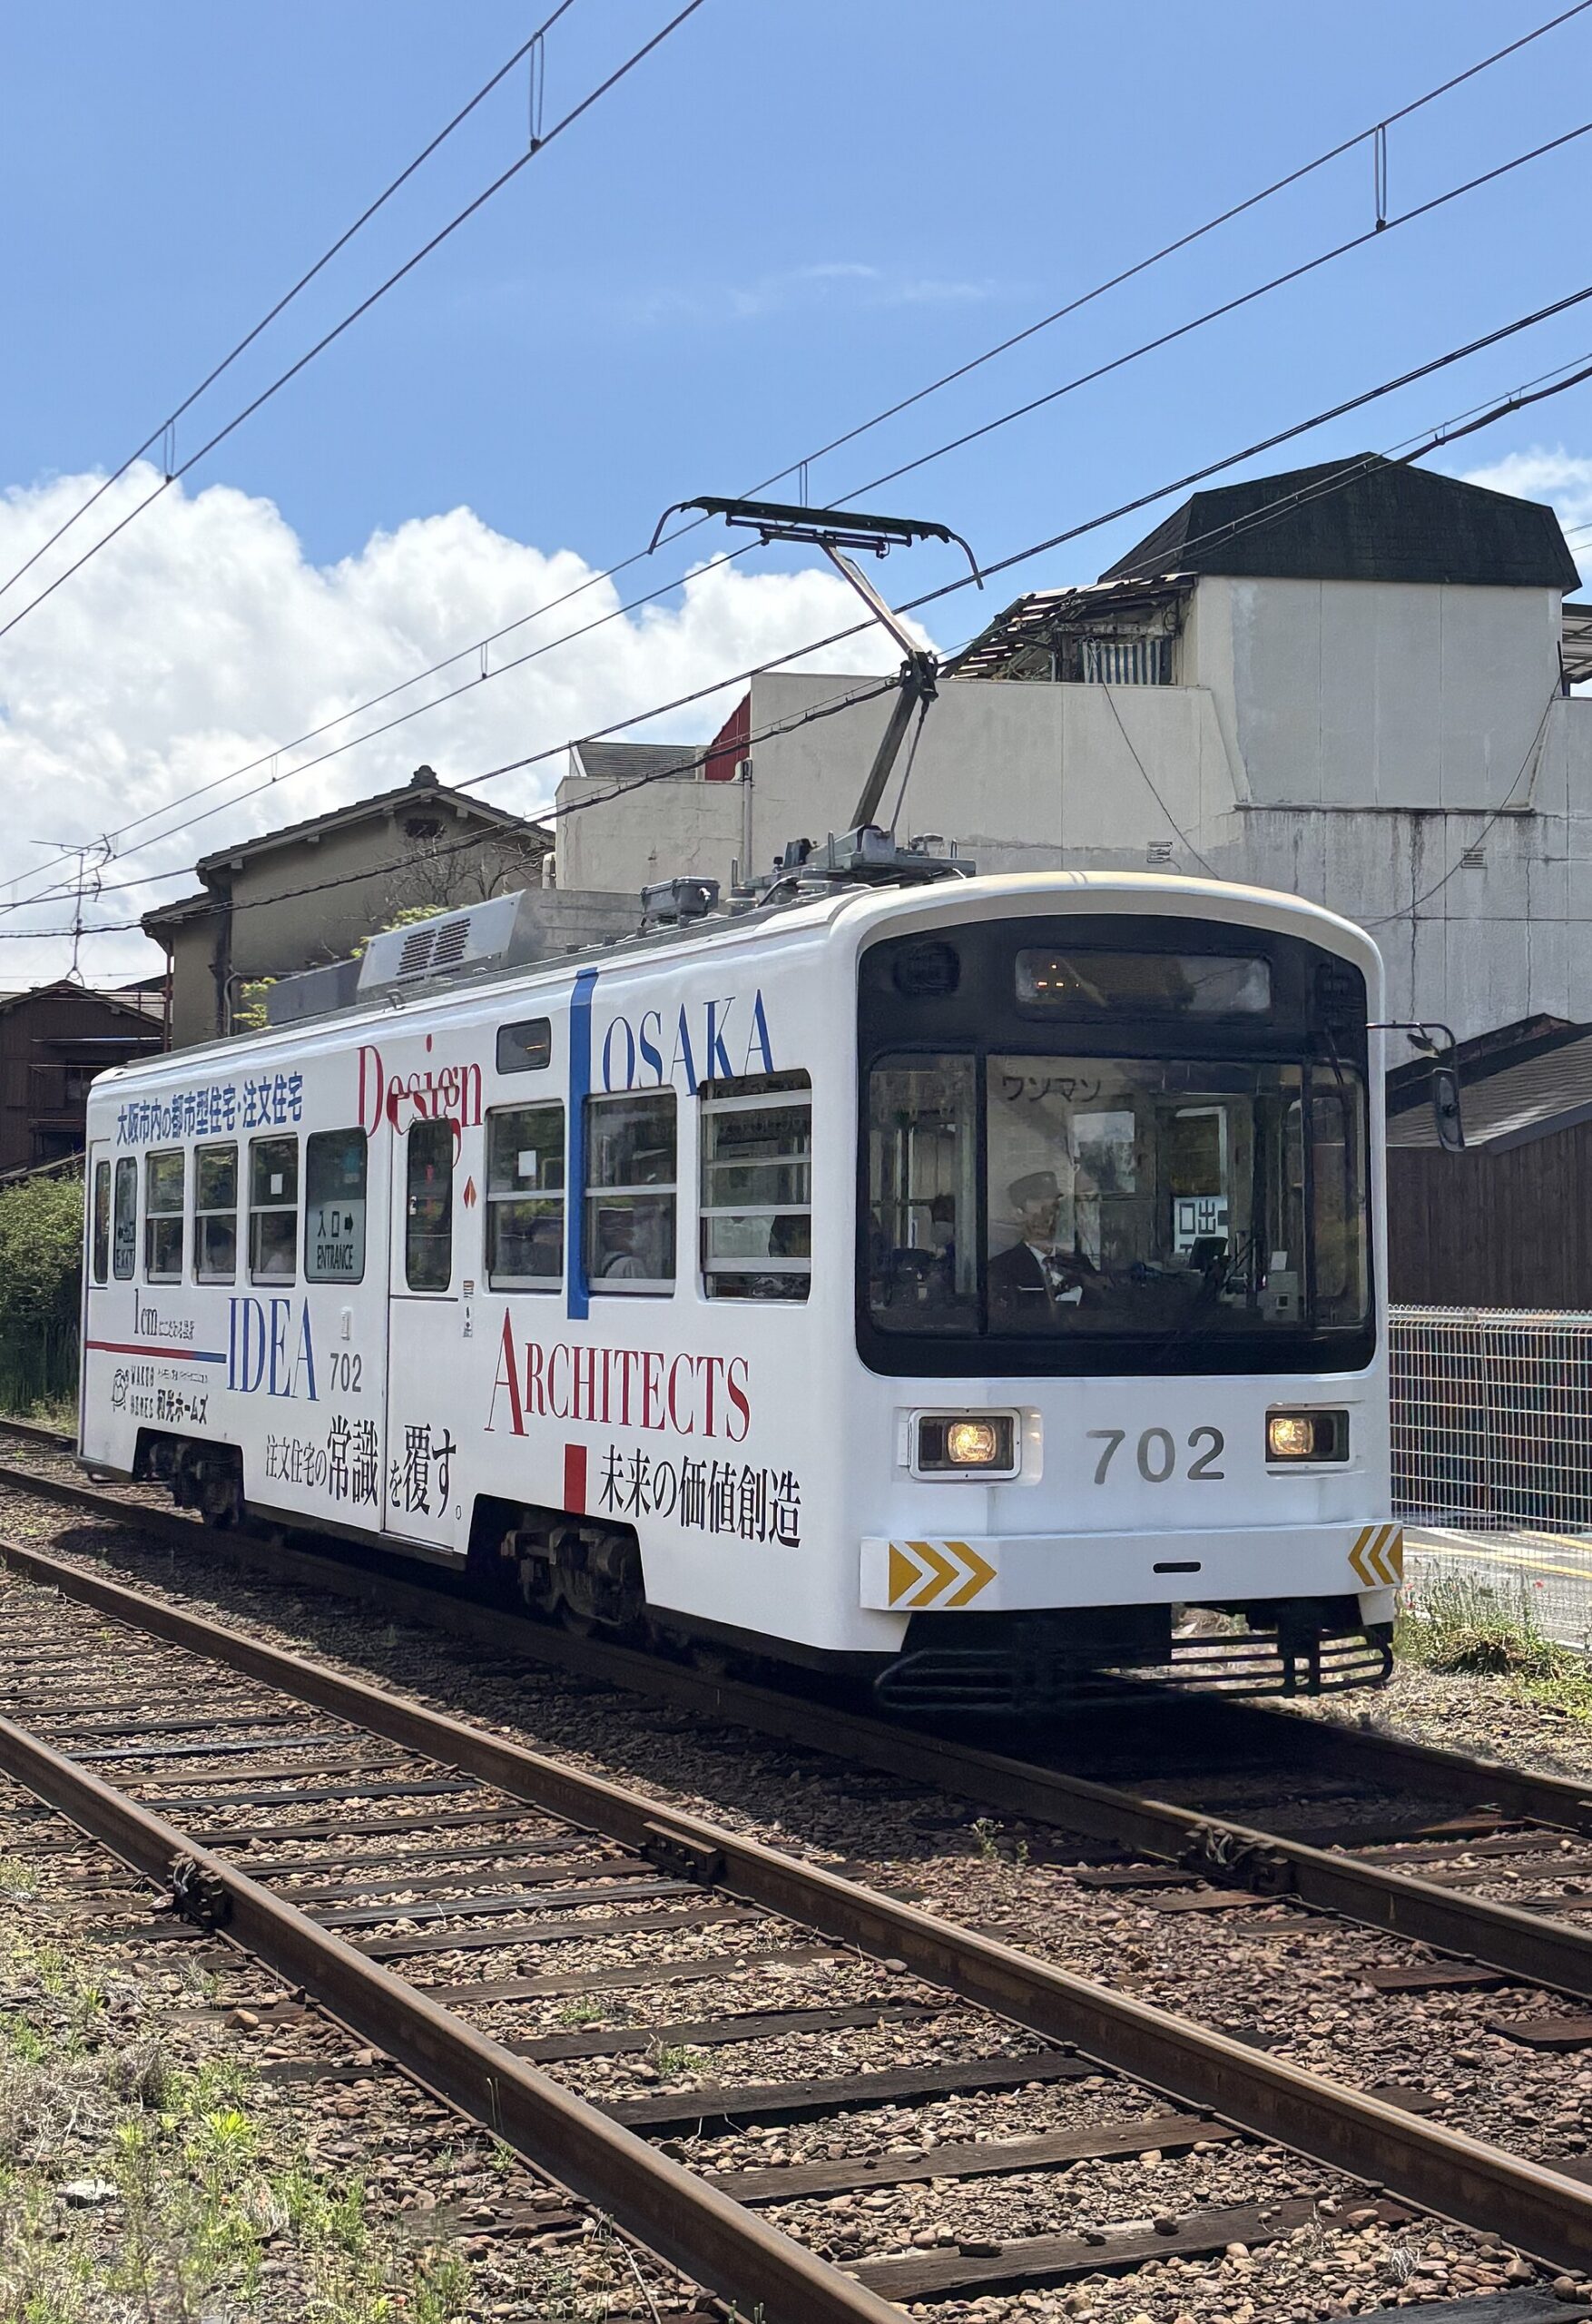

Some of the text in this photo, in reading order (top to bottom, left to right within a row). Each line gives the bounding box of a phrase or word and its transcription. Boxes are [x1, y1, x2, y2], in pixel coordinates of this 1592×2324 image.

[603, 989, 774, 1097] OSAKA
[357, 1034, 483, 1168] Design
[1002, 1076, 1102, 1103] ワンマン
[317, 1244, 353, 1270] ENTRANCE
[318, 1210, 340, 1238] 入口
[227, 1295, 320, 1402] IDEA
[329, 1353, 362, 1393] 702
[484, 1307, 750, 1443] ARCHITECTS
[598, 1443, 801, 1549] 未来の価値創造
[1086, 1426, 1225, 1485] 702
